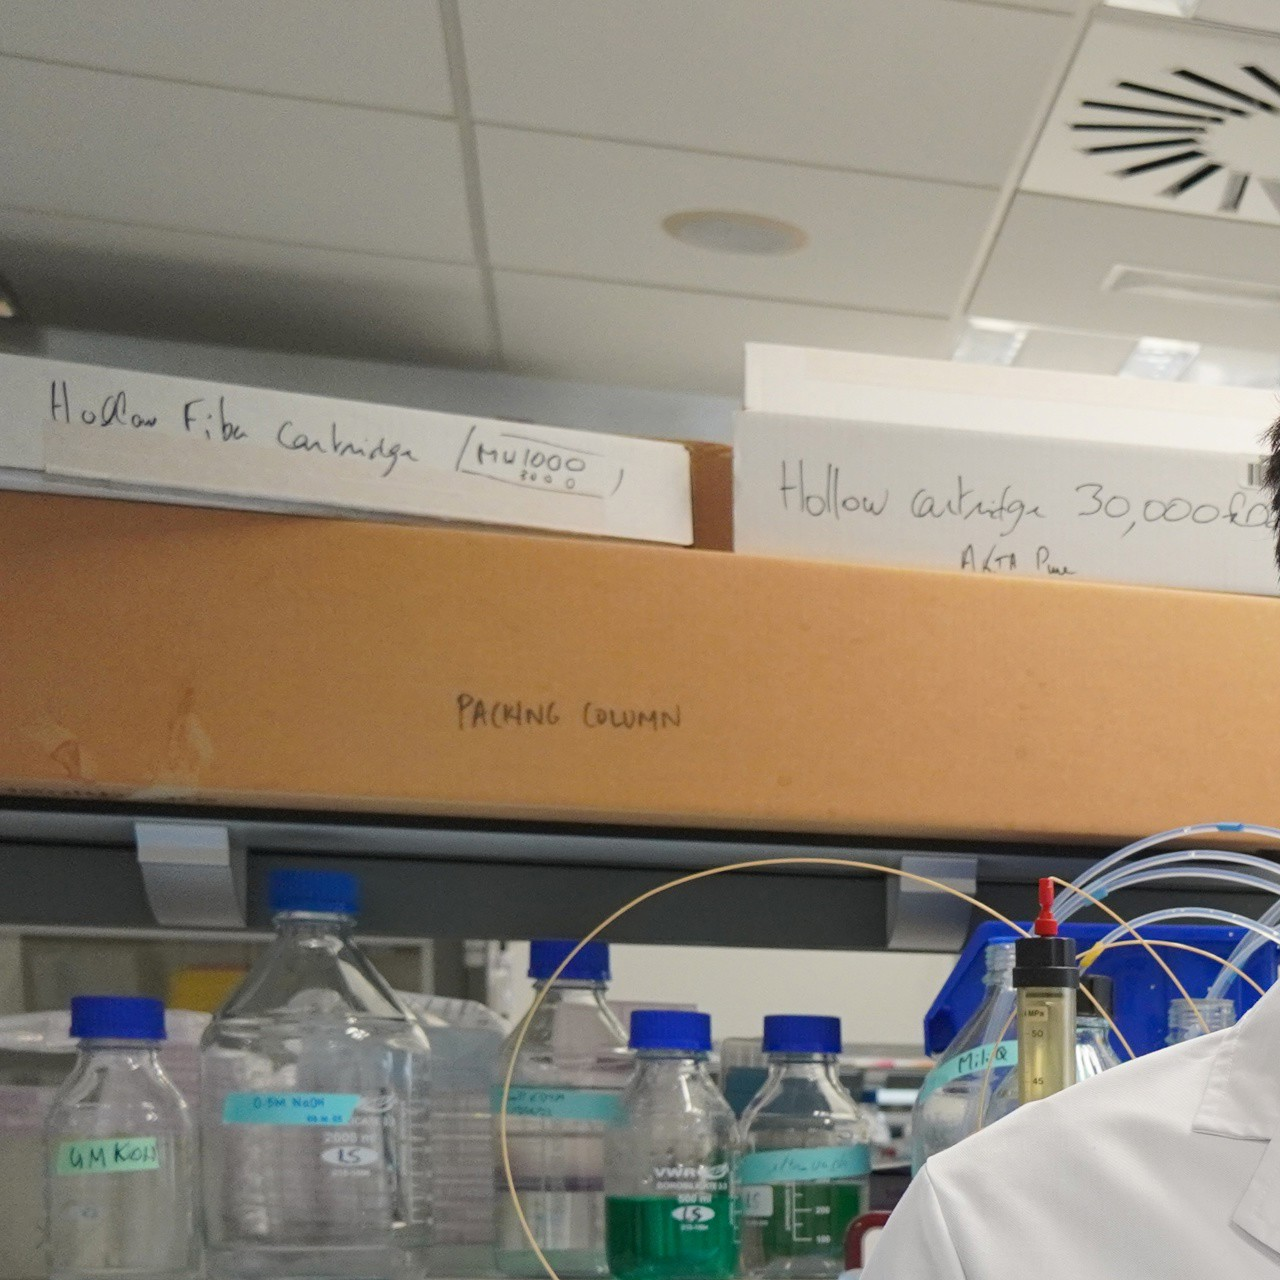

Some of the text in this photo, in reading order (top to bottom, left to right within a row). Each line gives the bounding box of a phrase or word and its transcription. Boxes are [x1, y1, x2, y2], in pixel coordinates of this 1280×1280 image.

[49, 380, 157, 429] Hollow
[780, 459, 889, 520] Hollow
[457, 693, 682, 731] PACKING COLUMN
[1031, 1029, 1044, 1038] 50
[1032, 1077, 1044, 1085] 45
